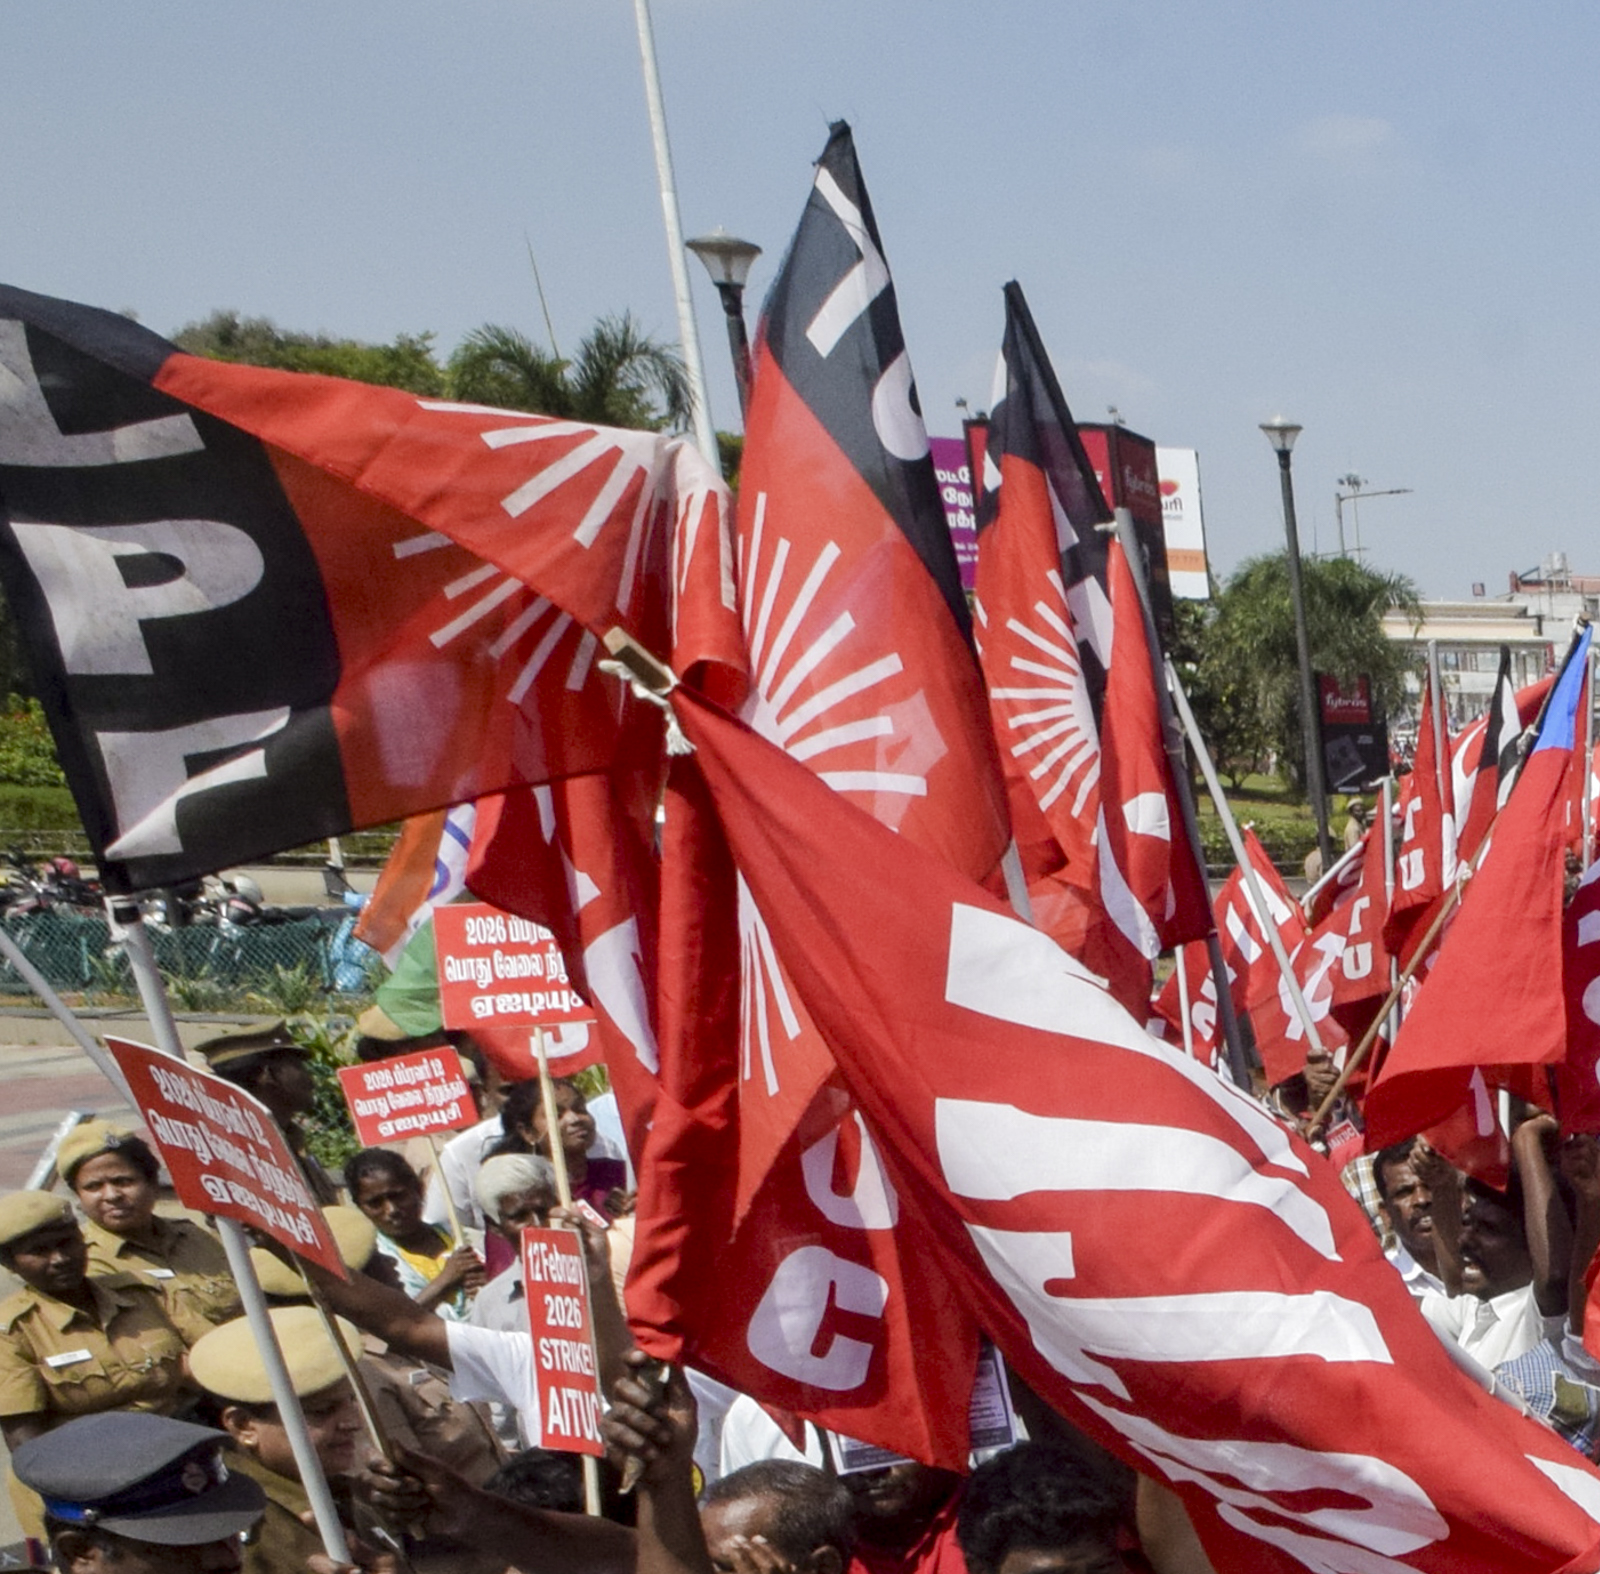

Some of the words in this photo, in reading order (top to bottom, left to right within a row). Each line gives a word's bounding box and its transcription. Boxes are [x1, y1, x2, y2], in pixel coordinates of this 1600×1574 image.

[465, 914, 507, 946] 2026
[444, 954, 494, 989] பொது
[493, 948, 544, 980] வேலை
[149, 1064, 203, 1115] 2026
[363, 1069, 395, 1092] 2026
[430, 1057, 446, 1078] 12
[354, 1096, 392, 1119] பொது
[148, 1108, 214, 1166] பொது
[527, 1241, 543, 1282] 12
[541, 1243, 585, 1296] February
[544, 1294, 583, 1330] 2026
[539, 1337, 596, 1377] STRIKE!
[547, 1385, 603, 1444] AITUC
